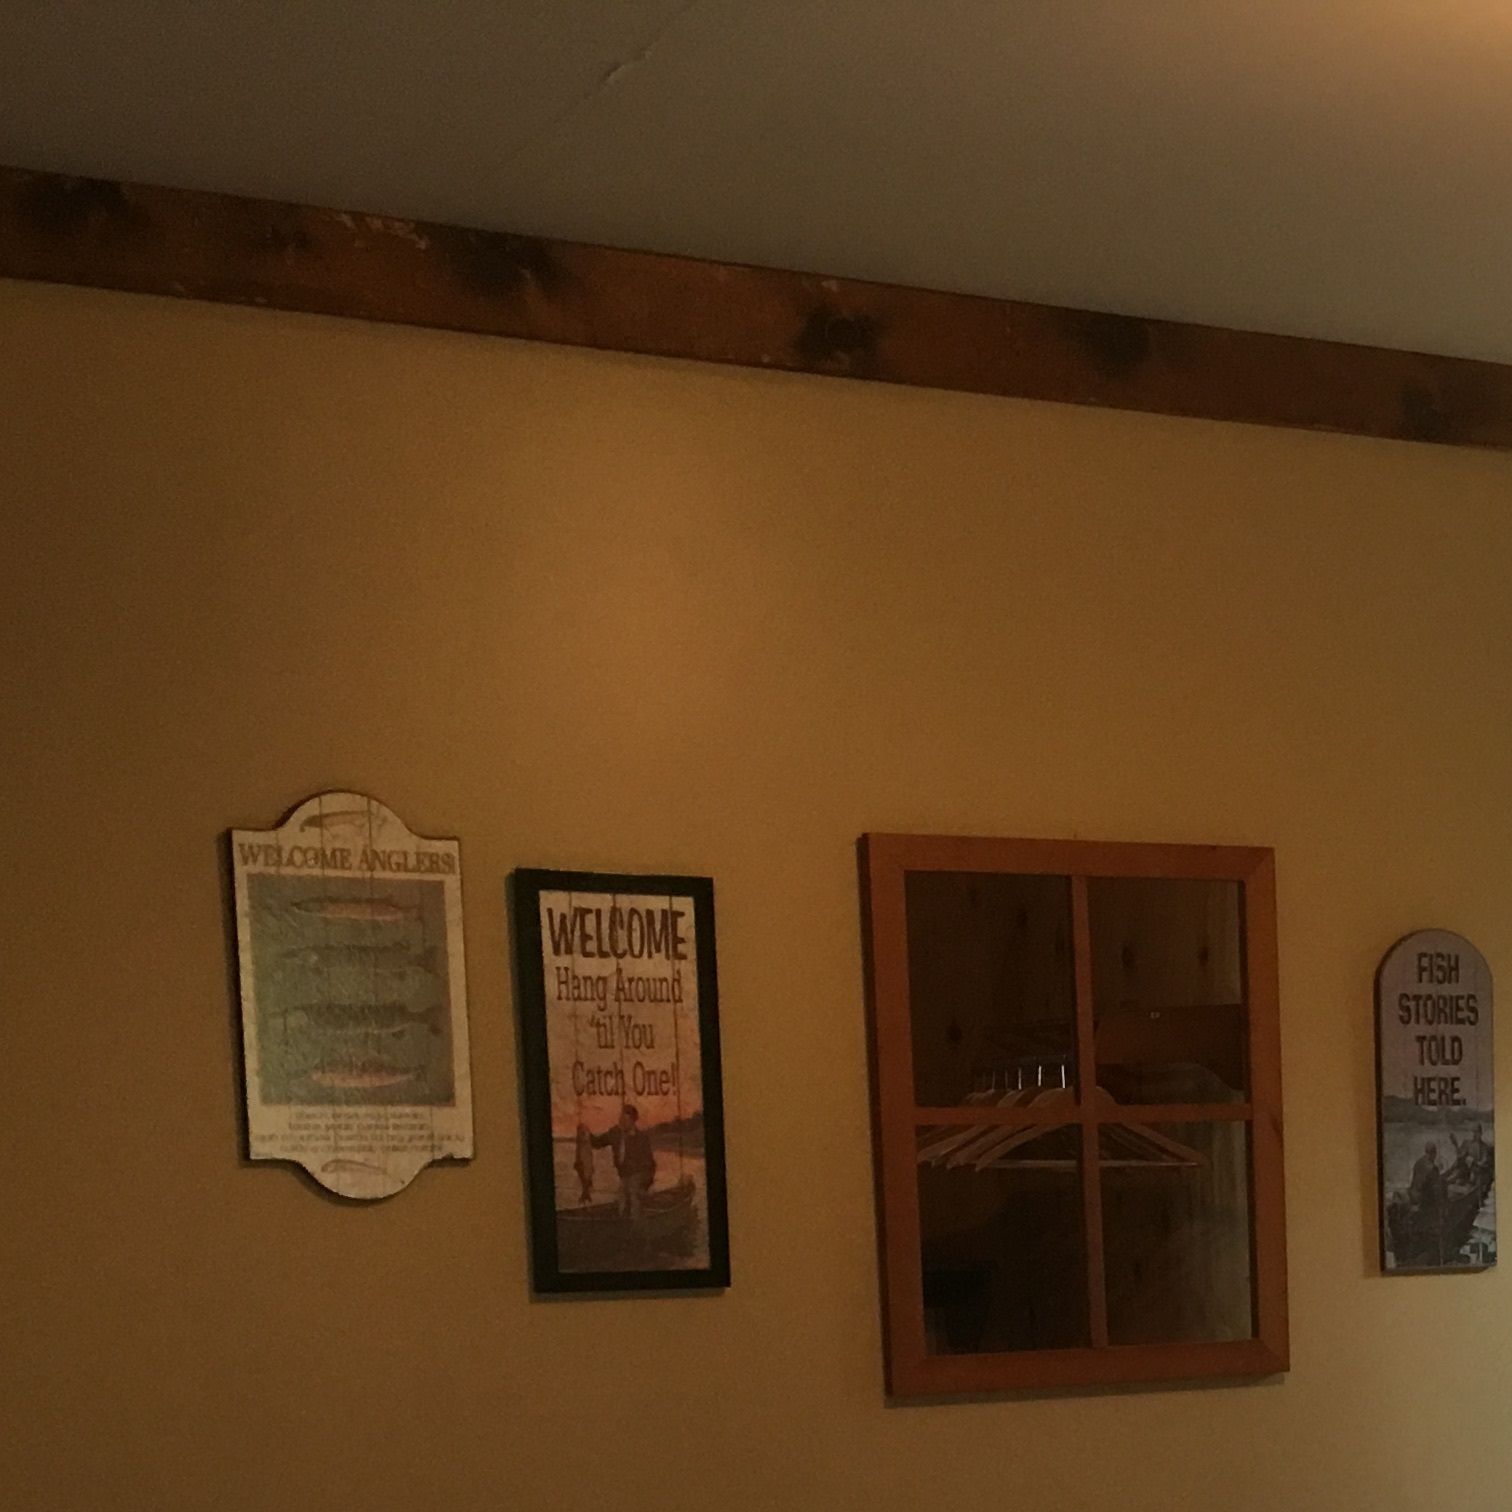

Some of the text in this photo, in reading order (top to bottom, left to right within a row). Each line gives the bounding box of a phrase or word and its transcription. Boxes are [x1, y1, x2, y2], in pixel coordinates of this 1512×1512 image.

[239, 843, 352, 871] WELCOME
[547, 906, 688, 960] WELCOME
[1416, 952, 1460, 984] FISH
[555, 966, 683, 1011] Hang Around
[1398, 994, 1479, 1026] STORIES
[620, 1015, 655, 1049] You
[1415, 1035, 1463, 1066] TOLD
[573, 1060, 678, 1097] Catch One!
[1413, 1076, 1466, 1107] HERE.
